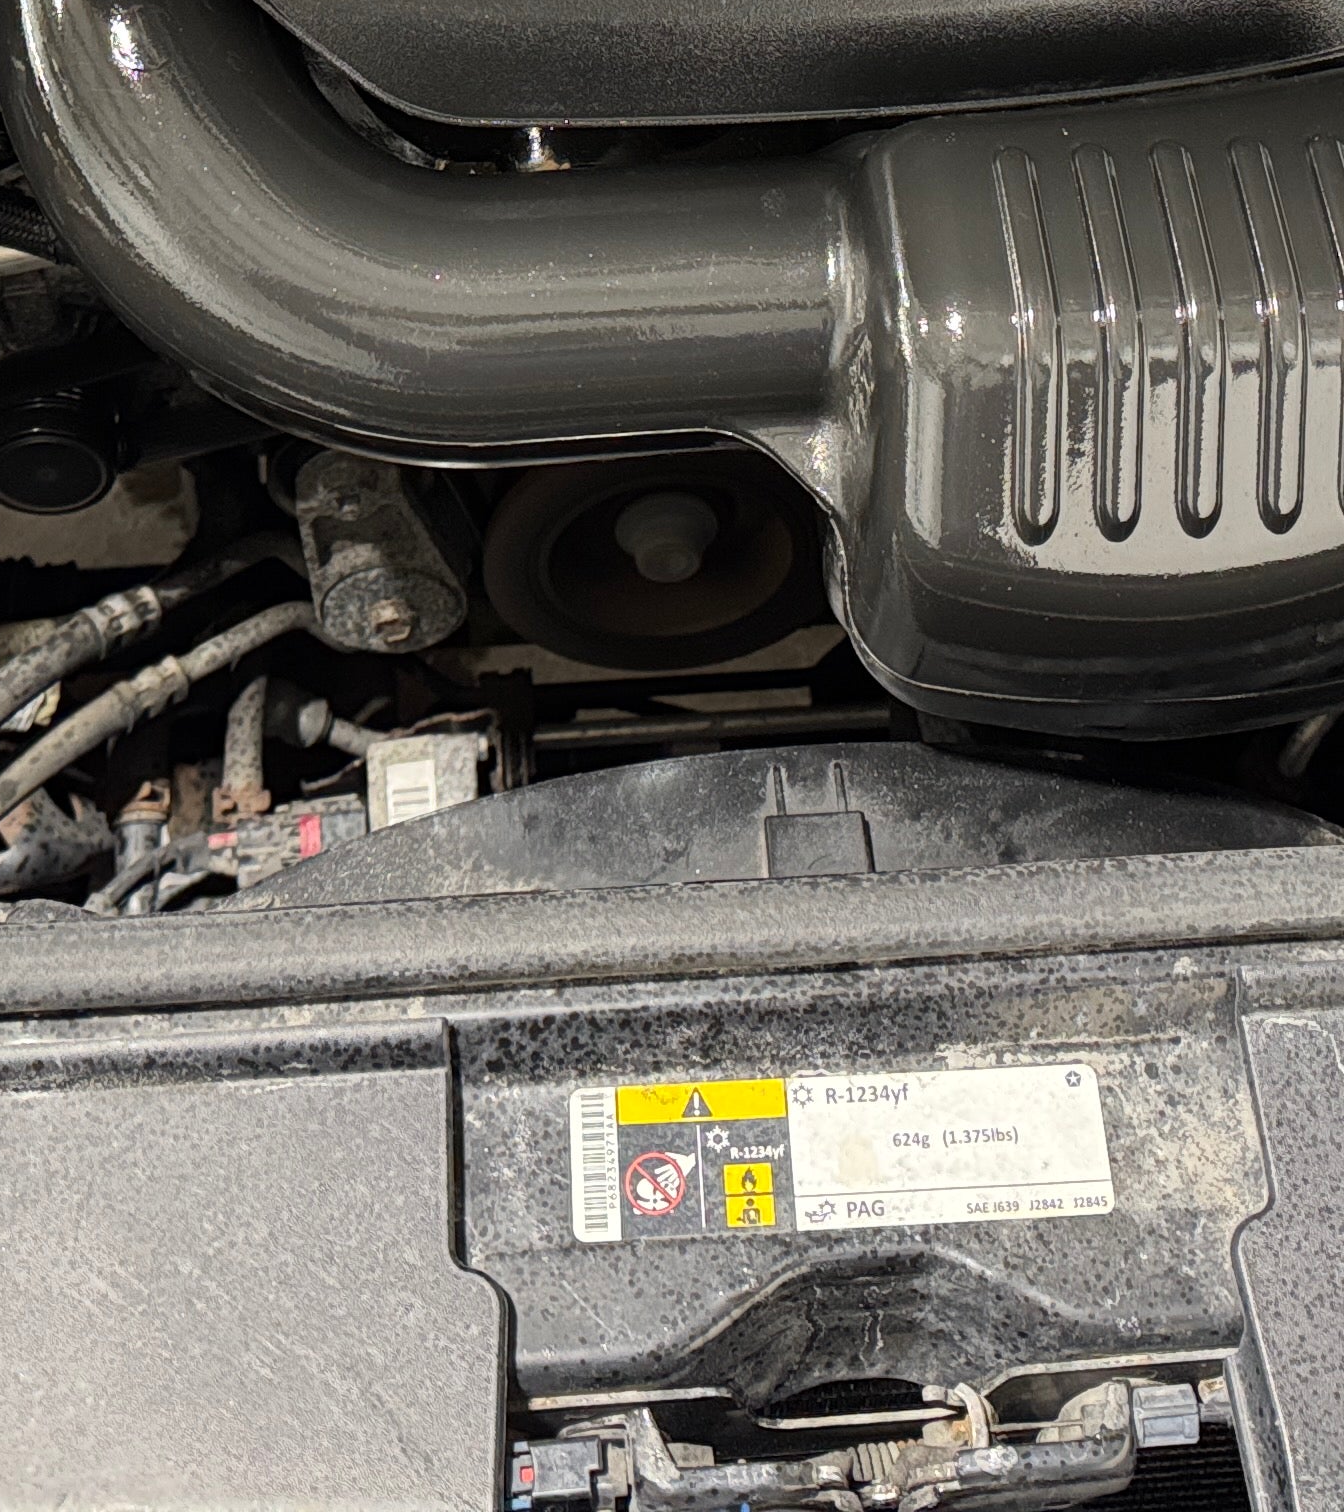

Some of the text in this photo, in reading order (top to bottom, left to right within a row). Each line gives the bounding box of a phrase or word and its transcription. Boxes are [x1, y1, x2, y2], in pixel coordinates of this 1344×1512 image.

[825, 1082, 909, 1110] R-1234yf
[892, 1125, 1019, 1150] 624g (1.375lbs)
[605, 1113, 618, 1209] P68234971AA
[729, 1143, 786, 1161] R-1234yf
[846, 1199, 886, 1219] PAG
[966, 1195, 1109, 1215] SAE J639 J2842 J2845
